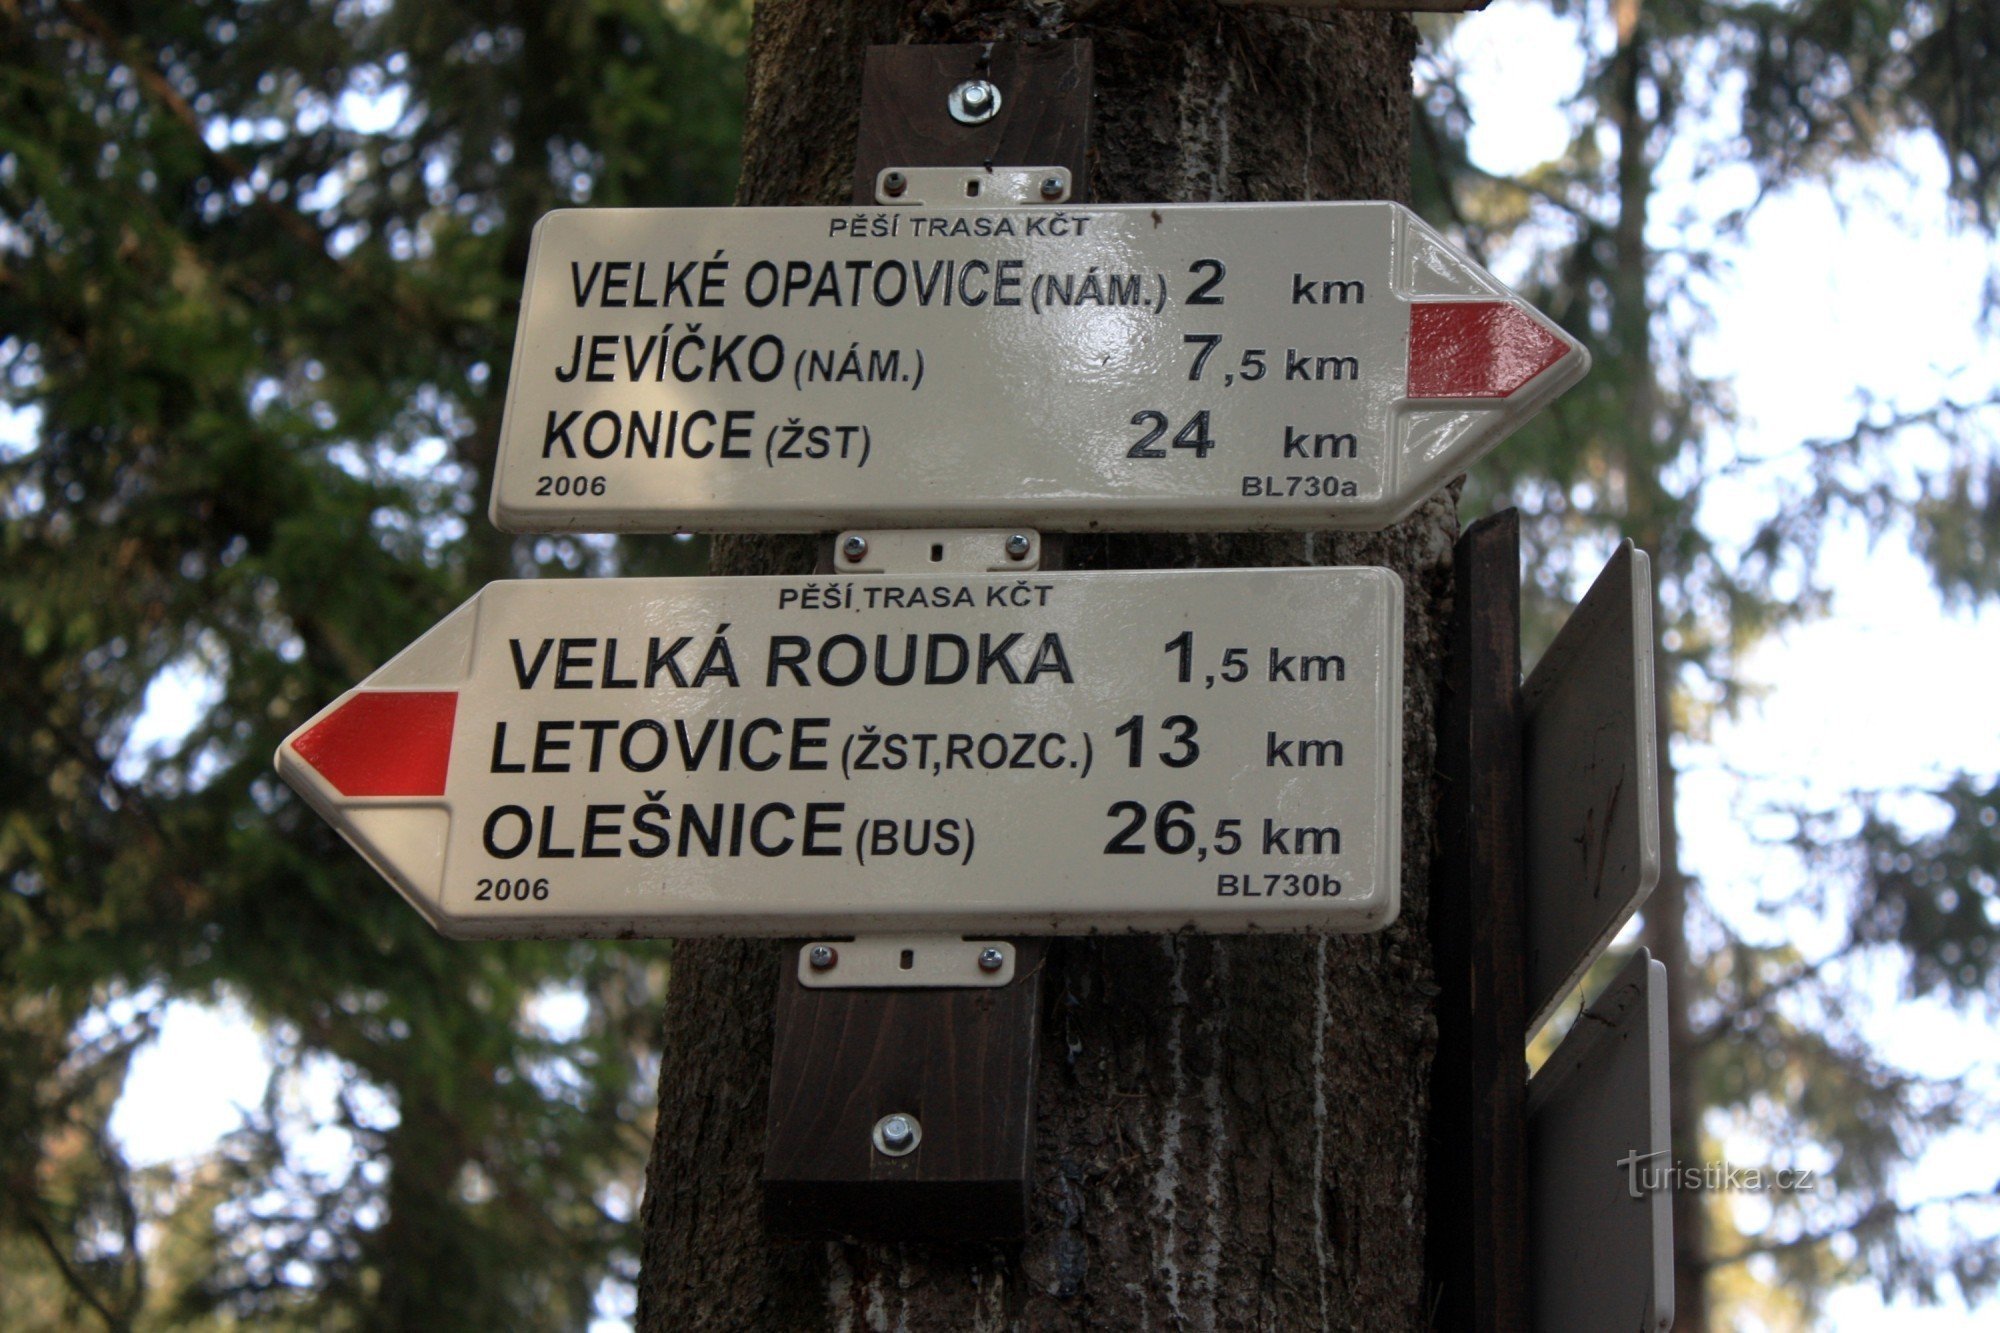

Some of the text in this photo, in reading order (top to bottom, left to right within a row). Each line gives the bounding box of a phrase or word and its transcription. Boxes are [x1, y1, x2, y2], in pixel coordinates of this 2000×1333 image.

[829, 212, 1090, 238] PĚŠÍ TRASA KČT
[571, 250, 729, 308] VELKÉ
[1185, 259, 1226, 305] 2
[1292, 273, 1365, 304] km
[555, 323, 784, 383] JEVÍČKO
[1183, 333, 1266, 387] 7,5
[1286, 348, 1359, 380] km
[542, 409, 755, 460] KONICE
[1126, 410, 1215, 459] 24
[1284, 425, 1357, 459] km
[535, 475, 606, 497] 2006
[1241, 475, 1357, 497] BL730a
[779, 581, 1053, 610] PĚŠÍ TRASA KČT
[509, 623, 1346, 690] VELKÁ ROUDKA 1,5 km
[489, 717, 830, 774] LETOVICE
[1114, 714, 1200, 769] 13
[1266, 731, 1343, 767] km
[482, 790, 845, 860] OLEŠNICE
[1104, 800, 1241, 863] 26,5
[1262, 818, 1341, 855] km
[474, 877, 550, 901] 2006
[1217, 873, 1342, 897] BL730b
